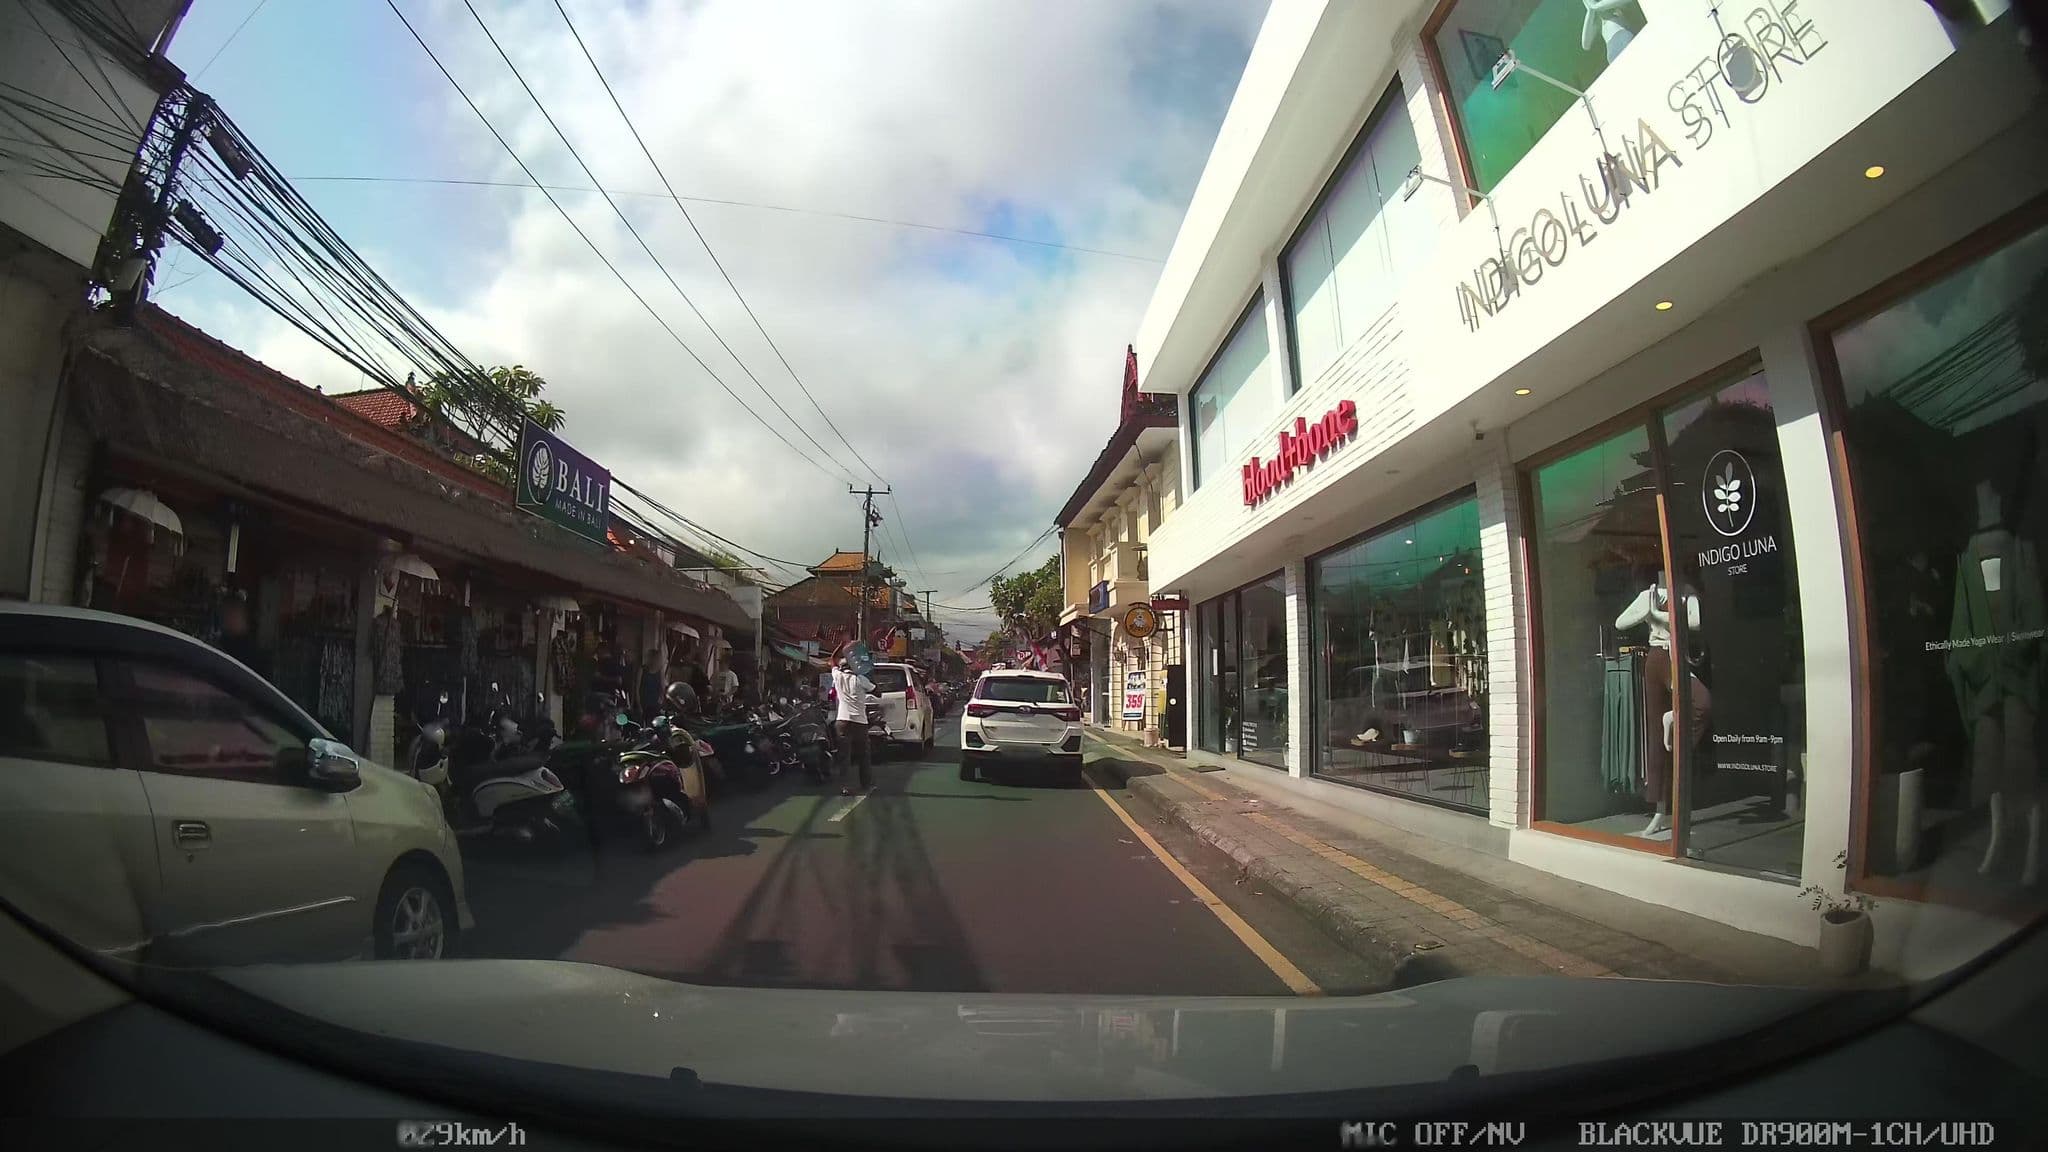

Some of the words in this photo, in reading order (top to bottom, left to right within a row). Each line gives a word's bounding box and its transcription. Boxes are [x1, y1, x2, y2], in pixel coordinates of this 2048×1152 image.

[1667, 0, 1828, 150] STORE
[556, 459, 605, 513] BALI
[554, 498, 576, 518] MADE
[1698, 544, 1740, 567] INDIGO
[1742, 535, 1777, 558] LUNA
[1727, 563, 1748, 576] STORE
[1925, 640, 1951, 651] Ethically
[1952, 639, 1970, 648] Made
[1970, 637, 1986, 648] Yoga
[1712, 734, 1727, 744] Open
[1727, 734, 1740, 745] Daily
[1741, 734, 1755, 743] from
